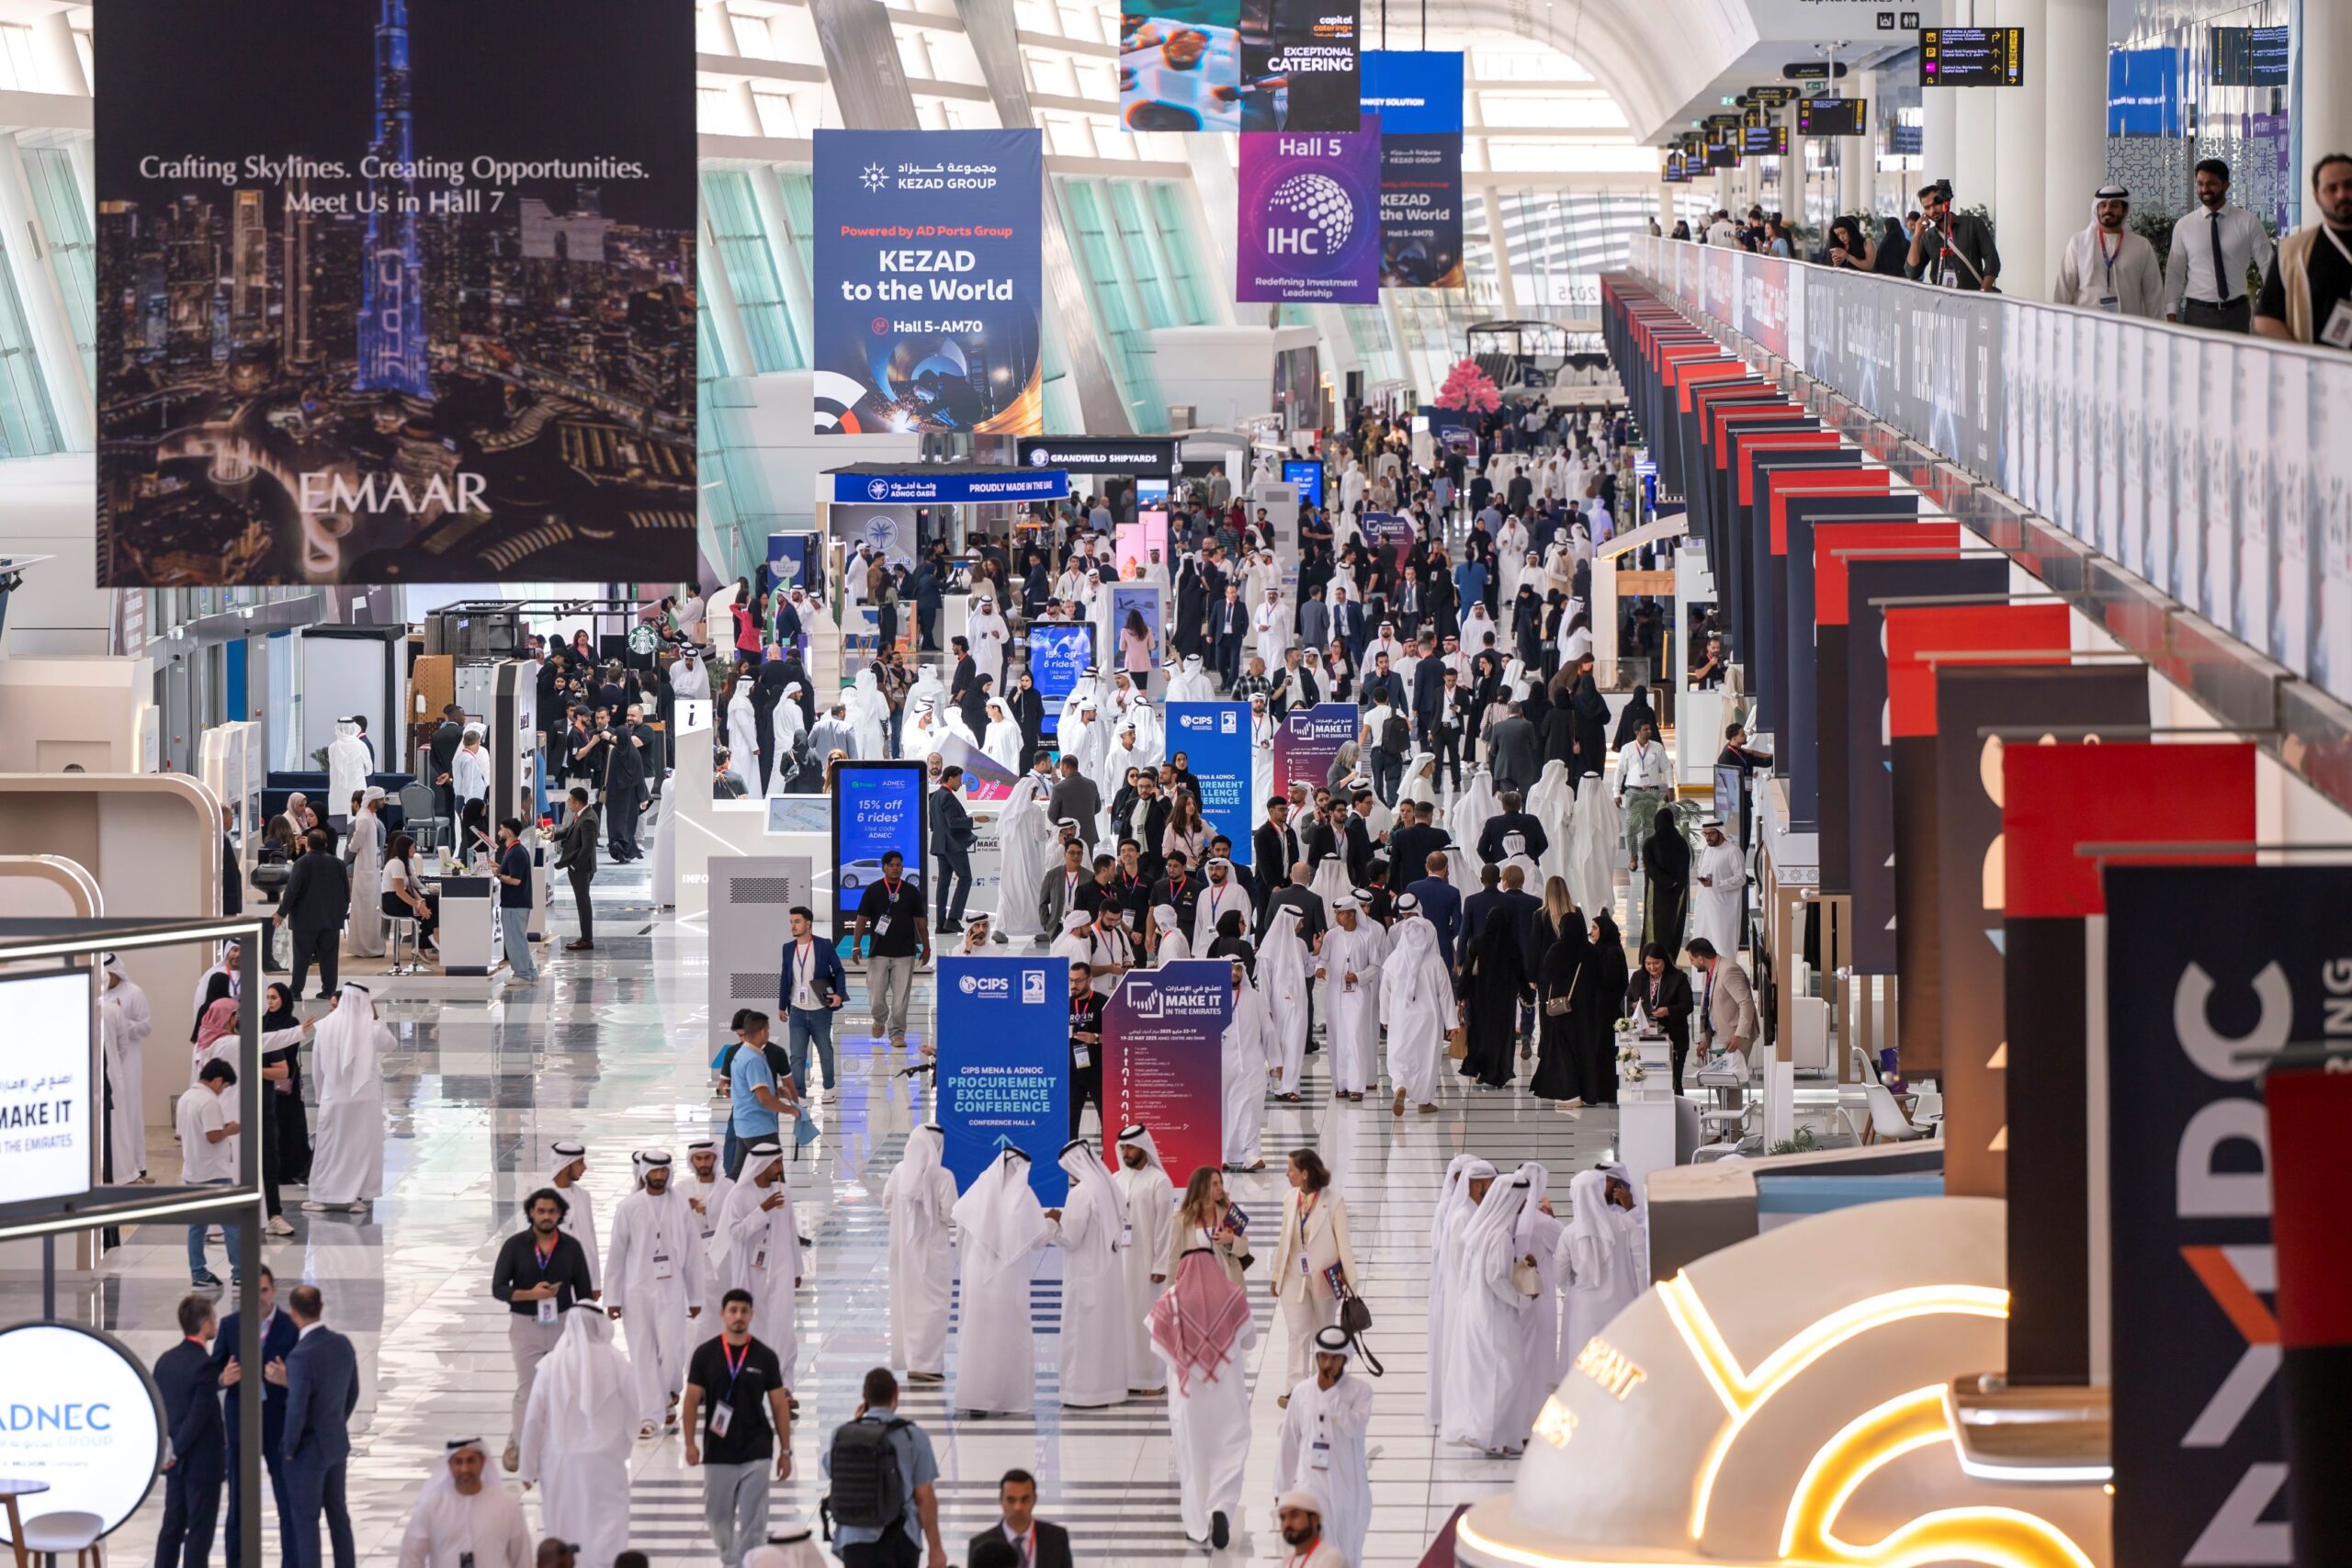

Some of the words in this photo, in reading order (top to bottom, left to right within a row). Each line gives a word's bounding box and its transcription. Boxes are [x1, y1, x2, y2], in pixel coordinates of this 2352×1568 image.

[1319, 16, 1353, 26] capital
[1283, 47, 1353, 56] EXCEPTIONAL
[1268, 58, 1353, 72] CATERING
[1785, 89, 1792, 98] 7
[1280, 138, 1321, 156] Hall
[1329, 139, 1342, 156] 5
[140, 155, 237, 185] Crafting
[243, 155, 351, 185] Skylines.
[359, 155, 464, 185] Creating
[470, 155, 650, 185] Opportunities.
[947, 163, 997, 175] مجموعة
[899, 178, 944, 189] KEZAD
[947, 178, 997, 189] GROUP
[285, 190, 351, 214] Meet
[355, 190, 390, 214] Us
[398, 190, 420, 214] in
[429, 190, 481, 214] Hall
[489, 190, 505, 214] 7
[1380, 195, 1430, 206] KEZAD
[1380, 209, 1404, 220] the
[1406, 209, 1450, 220] World
[841, 226, 896, 236] Powered
[899, 225, 913, 239] by
[916, 226, 935, 236] AD
[937, 226, 972, 236] Ports
[974, 226, 1012, 239] Group
[1268, 228, 1318, 254] IHC
[879, 250, 976, 272] KEZAD
[1255, 277, 1305, 288] Redefining
[1306, 278, 1358, 287] Investment
[842, 281, 872, 300] to
[877, 279, 923, 300] the
[929, 279, 1012, 300] World
[1283, 289, 1333, 299] Leadership
[893, 321, 922, 333] Hall
[924, 321, 983, 333] 5-AM70
[1050, 454, 1106, 463] GRANDWELD
[1109, 454, 1158, 463] SHIPYARDS
[299, 471, 492, 513] EMAAR
[969, 483, 1005, 493] PROUDLY
[1006, 482, 1025, 492] MADE
[1025, 482, 1032, 491] IN
[1032, 481, 1043, 491] THE
[1043, 480, 1053, 490] UAE
[1192, 716, 1213, 725] CIPS
[1315, 725, 1341, 733] MAKE
[1344, 725, 1352, 733] IT
[1199, 781, 1244, 789] UREMENT
[858, 799, 881, 809] 15%
[884, 799, 903, 809] off
[1203, 796, 1240, 805] ERENCE
[857, 812, 865, 822] 6
[683, 874, 708, 884] INFO
[977, 977, 1009, 990] CIPS
[1165, 995, 1205, 1007] MAKE
[1209, 995, 1222, 1007] IT
[947, 1077, 1057, 1088] PROCUREMENT
[956, 1089, 1048, 1100] EXCELLENCE
[56, 1100, 72, 1123] IT
[954, 1101, 1050, 1112] CONFERENCE
[25, 1133, 73, 1152] EMIRATES
[0, 1403, 111, 1431] DNEC
